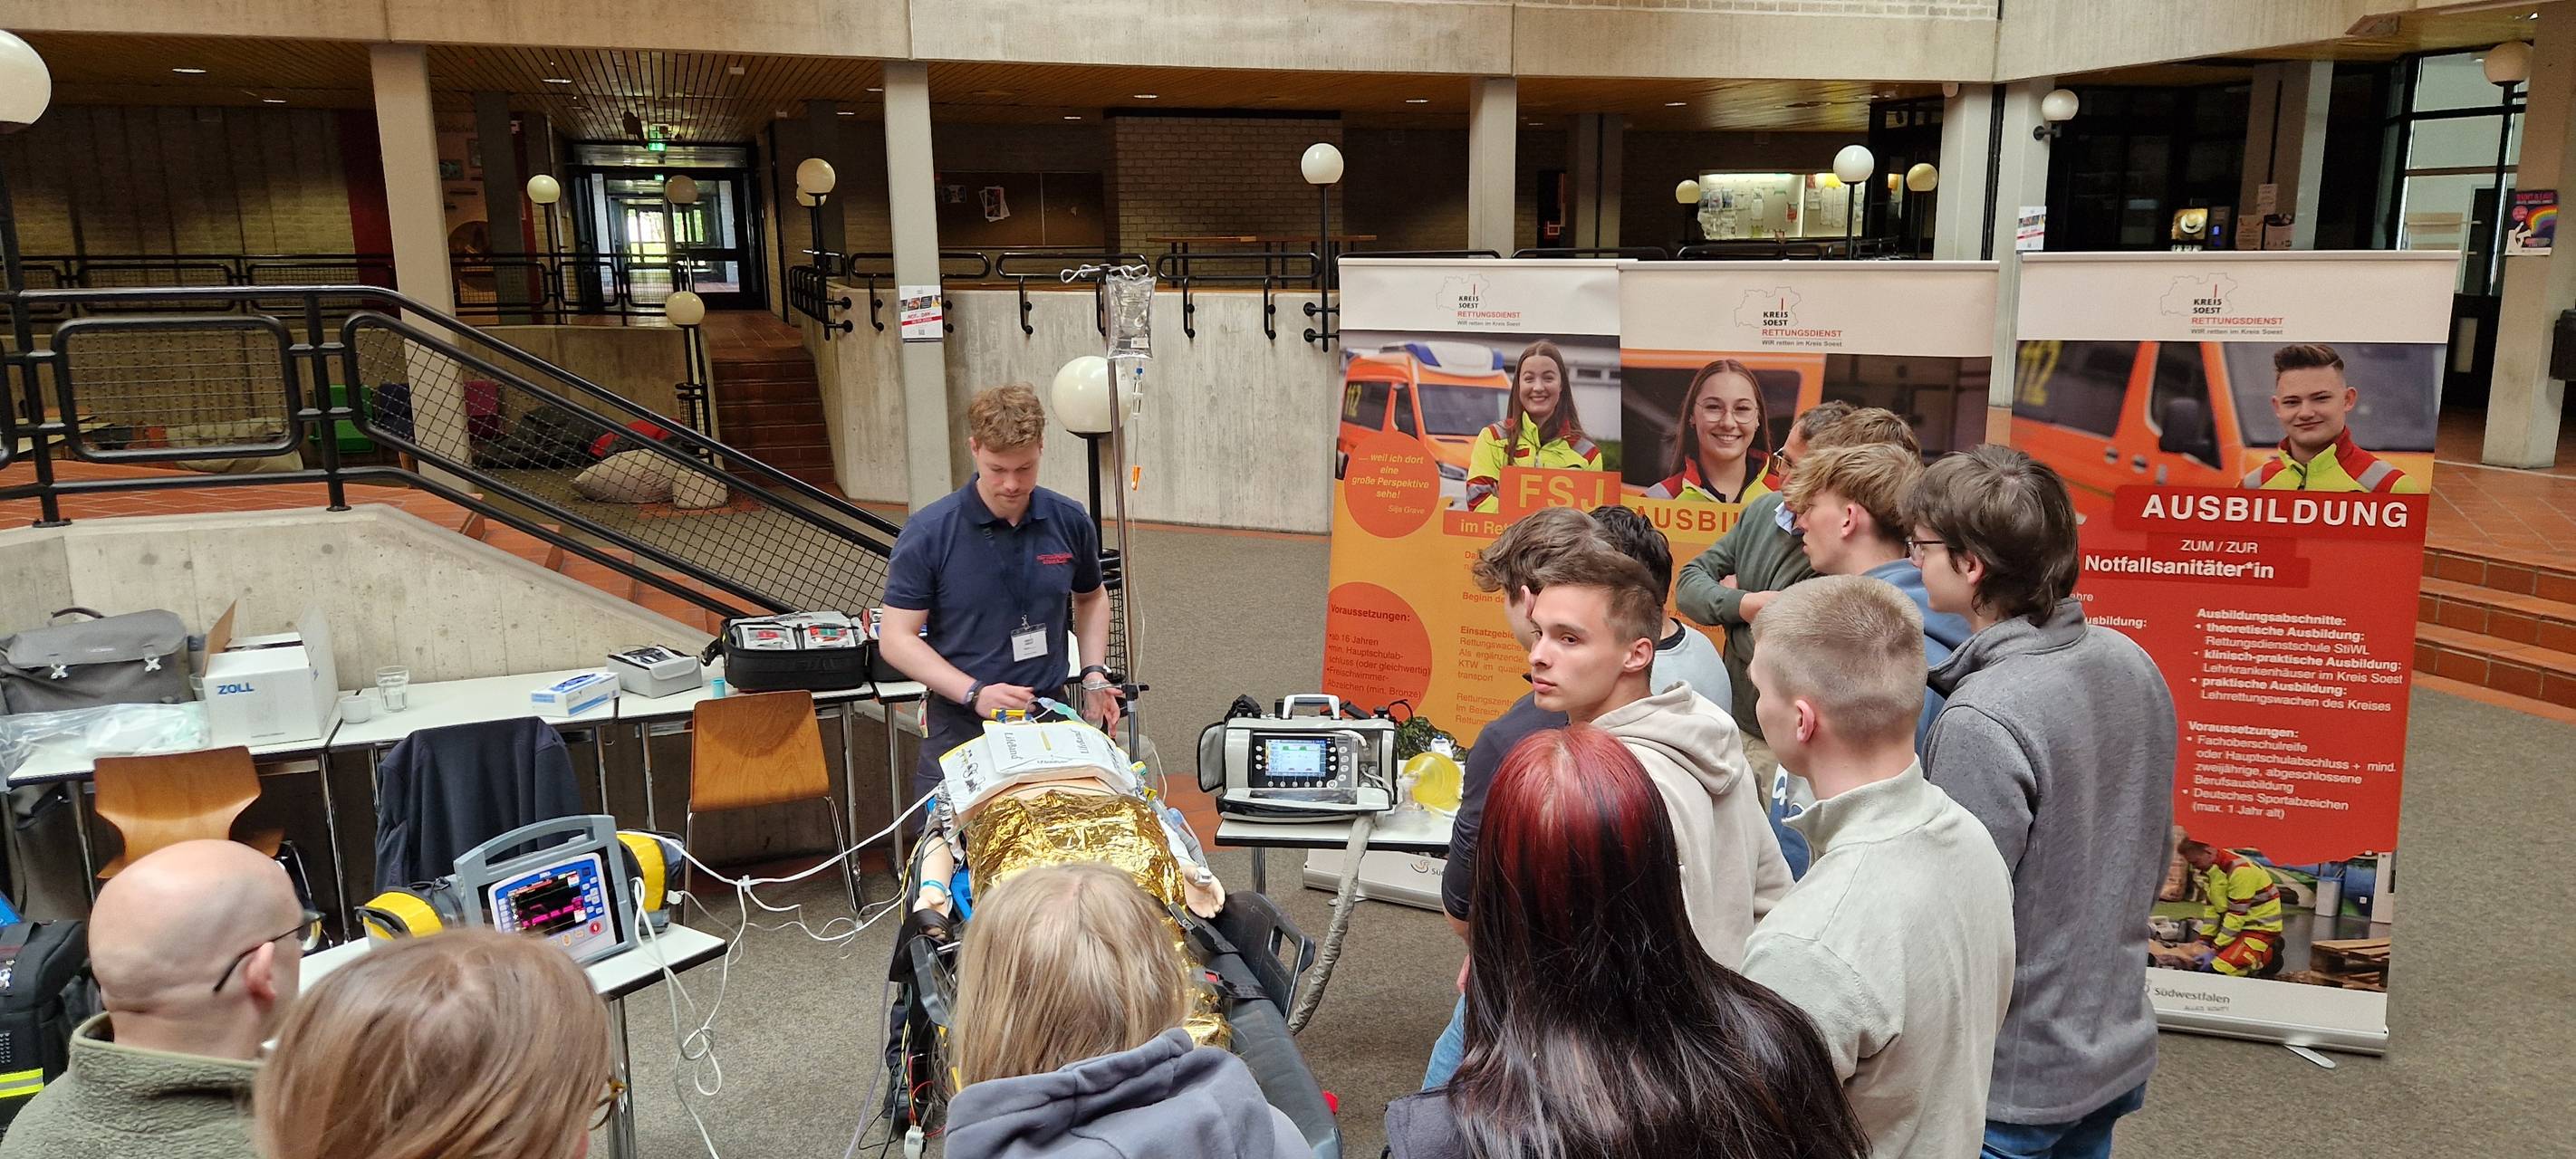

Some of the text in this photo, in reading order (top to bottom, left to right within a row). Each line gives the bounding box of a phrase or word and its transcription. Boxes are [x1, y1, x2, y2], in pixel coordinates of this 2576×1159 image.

[2194, 298, 2222, 306] KREIS
[1456, 311, 1521, 319] RETTUNGSDIENST
[2191, 317, 2283, 325] RETTUNGSDIENST
[1762, 329, 1842, 338] RETTUNGSDIENST
[1370, 454, 1388, 462] weil
[1389, 454, 1403, 463] ich
[1405, 455, 1424, 465] dort
[1379, 465, 1399, 475] eine
[1351, 476, 1429, 489] große Perspektive
[1376, 489, 1400, 499] sehe!
[1519, 474, 1605, 512] FSJ
[2141, 493, 2409, 528] AUSBILDUNG
[1460, 519, 1478, 532] im
[2181, 539, 2215, 552] ZUM
[2225, 541, 2259, 554] ZUR
[1462, 591, 1493, 603] Beginn
[2070, 591, 2094, 602] ahre
[1331, 604, 1410, 622] Voraussetzungen:
[2196, 608, 2347, 626] Ausbildungsabschnitte:
[2085, 616, 2148, 629] usbildung:
[1460, 625, 1515, 638] Einsatzgebie
[2206, 622, 2365, 643] theoretische Ausbildung:
[1351, 636, 1379, 646] Jahren
[2205, 636, 2331, 652] Rettungsdienstschule
[1346, 647, 1404, 660] Hauptschulab-
[2204, 649, 2402, 673] klinisch-praktische Ausbildung:
[1356, 659, 1378, 669] (oder
[1379, 662, 1431, 676] gleichwertig)
[1458, 659, 1479, 669] KTW
[1457, 671, 1494, 682] transport
[2203, 663, 2403, 684] Lehrkrankenhäuser im Kreis Soest
[217, 682, 255, 694] ZOLL
[1327, 679, 1364, 692] Abzeichen
[1389, 687, 1421, 699] Bronze)
[2202, 677, 2348, 697] praktische Ausbildung:
[1456, 693, 1514, 706] Rettungszentr
[2201, 689, 2391, 712] Lehrrettungswachen des Kreises
[1455, 714, 1487, 725] Rettun
[2187, 721, 2299, 739] Voraussetzungen:
[2197, 735, 2308, 752] Fachoberschulreife
[2196, 750, 2223, 759] oder
[2225, 751, 2350, 770] Hauptschulabschluss
[2367, 761, 2397, 772] mind.
[2194, 774, 2294, 794] Berufsausbildung
[2265, 768, 2362, 785] abgeschlossene
[2193, 788, 2349, 810] Deutsches Sportabzeichen
[2192, 801, 2285, 820] (max. 1 Jahr alt)
[2154, 987, 2230, 1003] Südwestfalen
